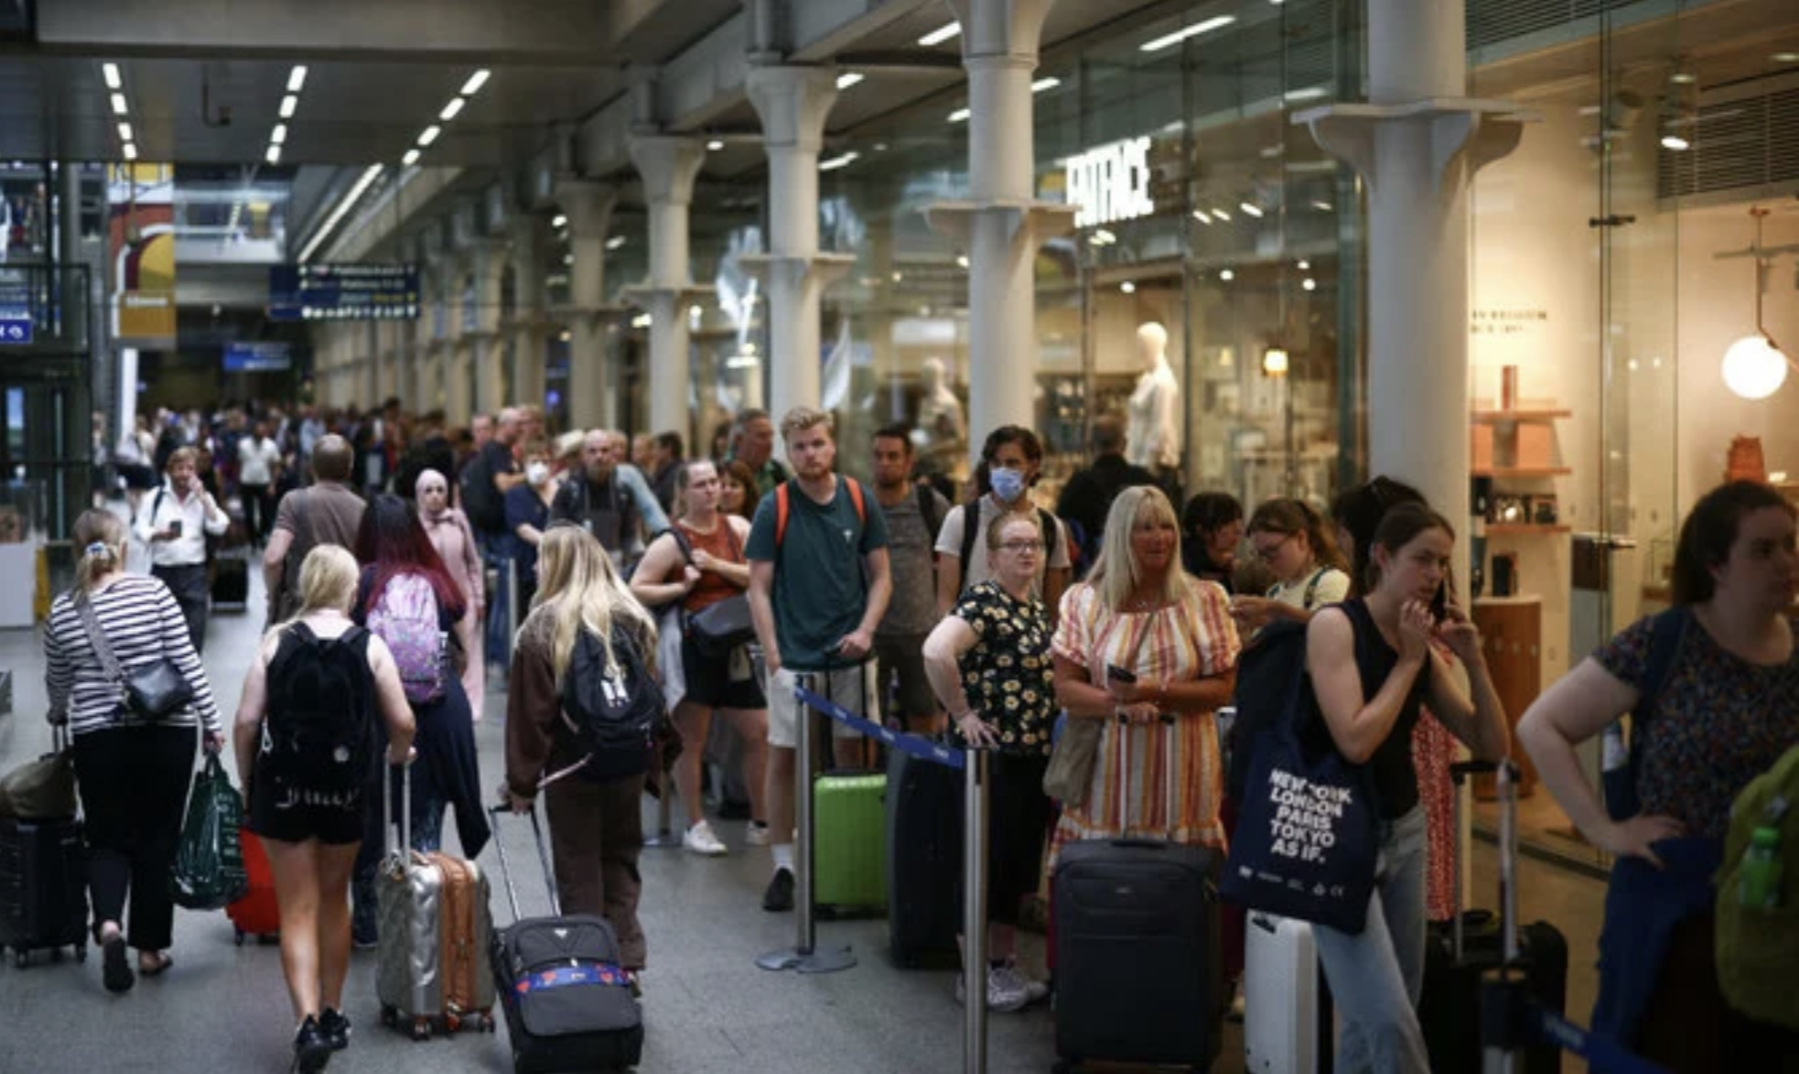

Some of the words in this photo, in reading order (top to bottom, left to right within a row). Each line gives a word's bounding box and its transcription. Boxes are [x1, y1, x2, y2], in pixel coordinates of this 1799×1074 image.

[1269, 768, 1307, 791] NEW
[1270, 787, 1342, 818] LONDON
[1276, 805, 1331, 830] PARIS
[1270, 818, 1335, 847] TOKYO
[1270, 838, 1299, 858] AS
[1301, 844, 1326, 864] IF.
